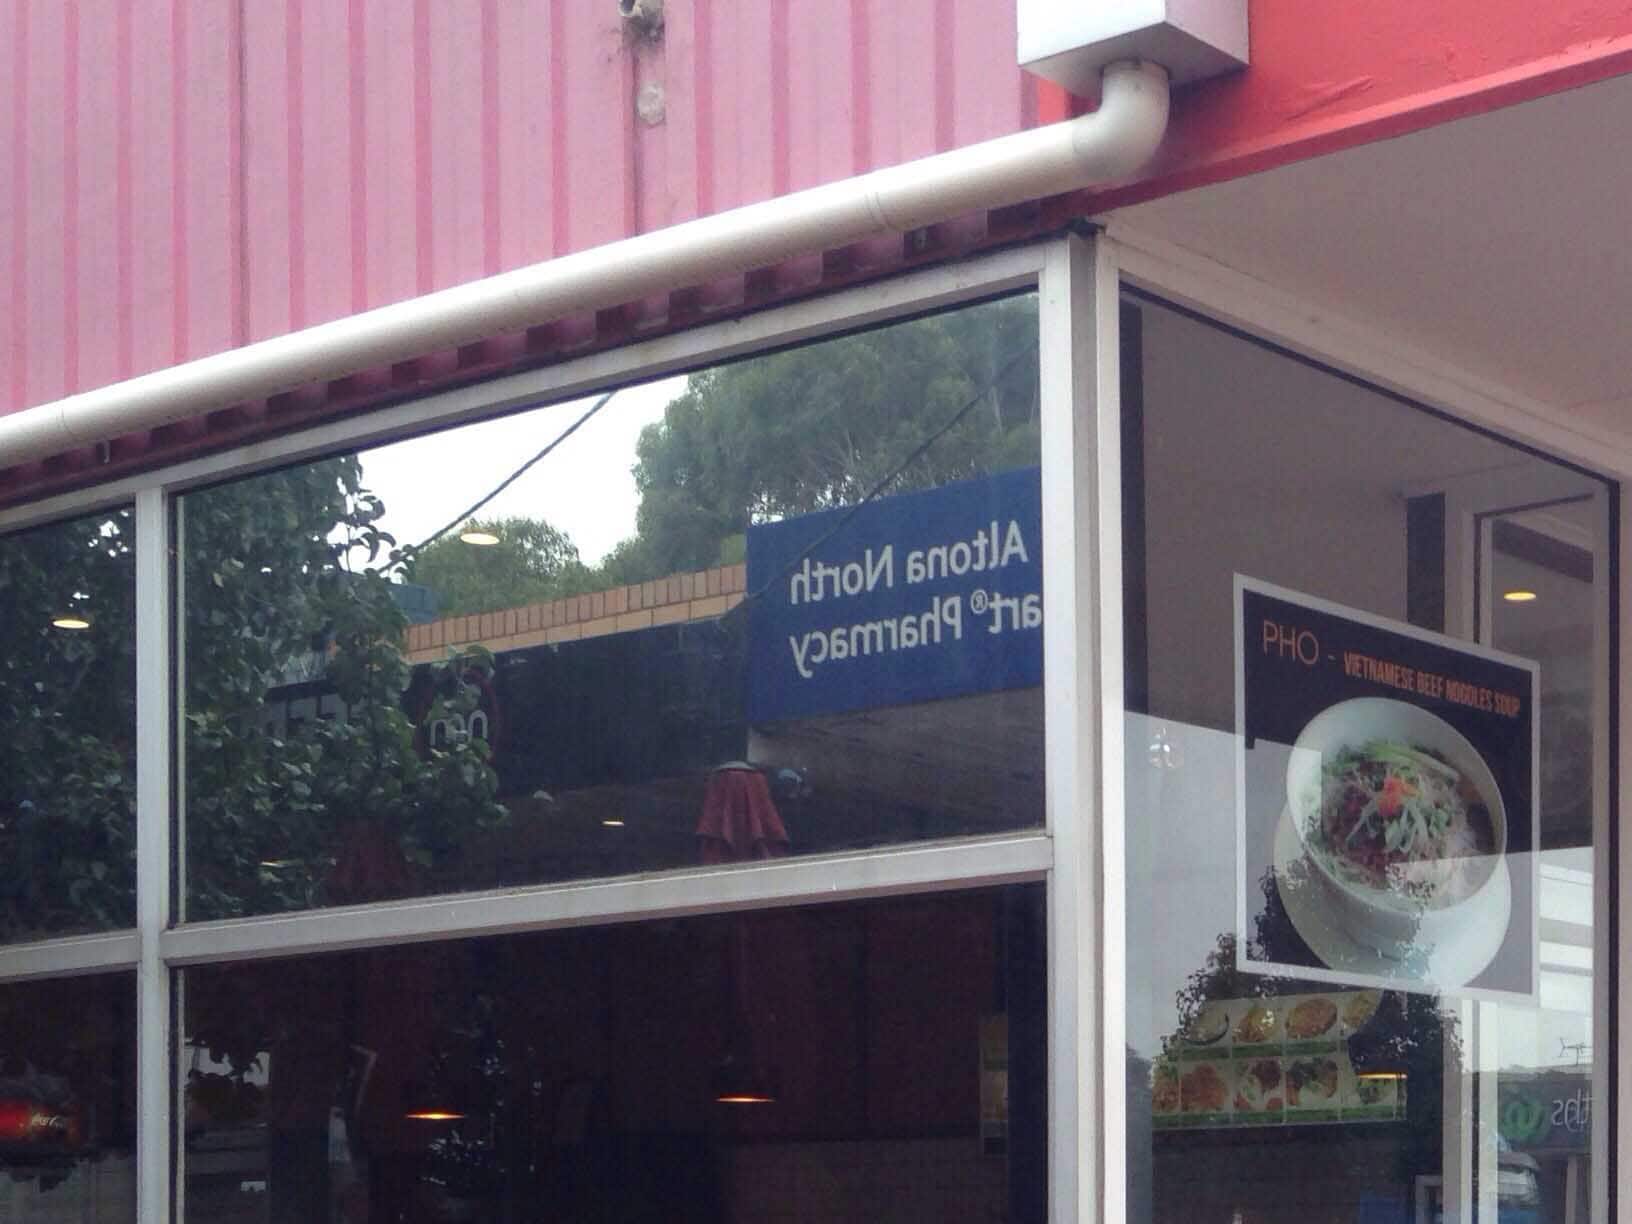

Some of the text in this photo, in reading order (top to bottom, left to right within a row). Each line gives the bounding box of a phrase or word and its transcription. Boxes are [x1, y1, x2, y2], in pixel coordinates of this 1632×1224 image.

[1263, 618, 1320, 666] PHO
[1343, 650, 1416, 692] VIETNAMESE
[1416, 670, 1444, 698] BEEF
